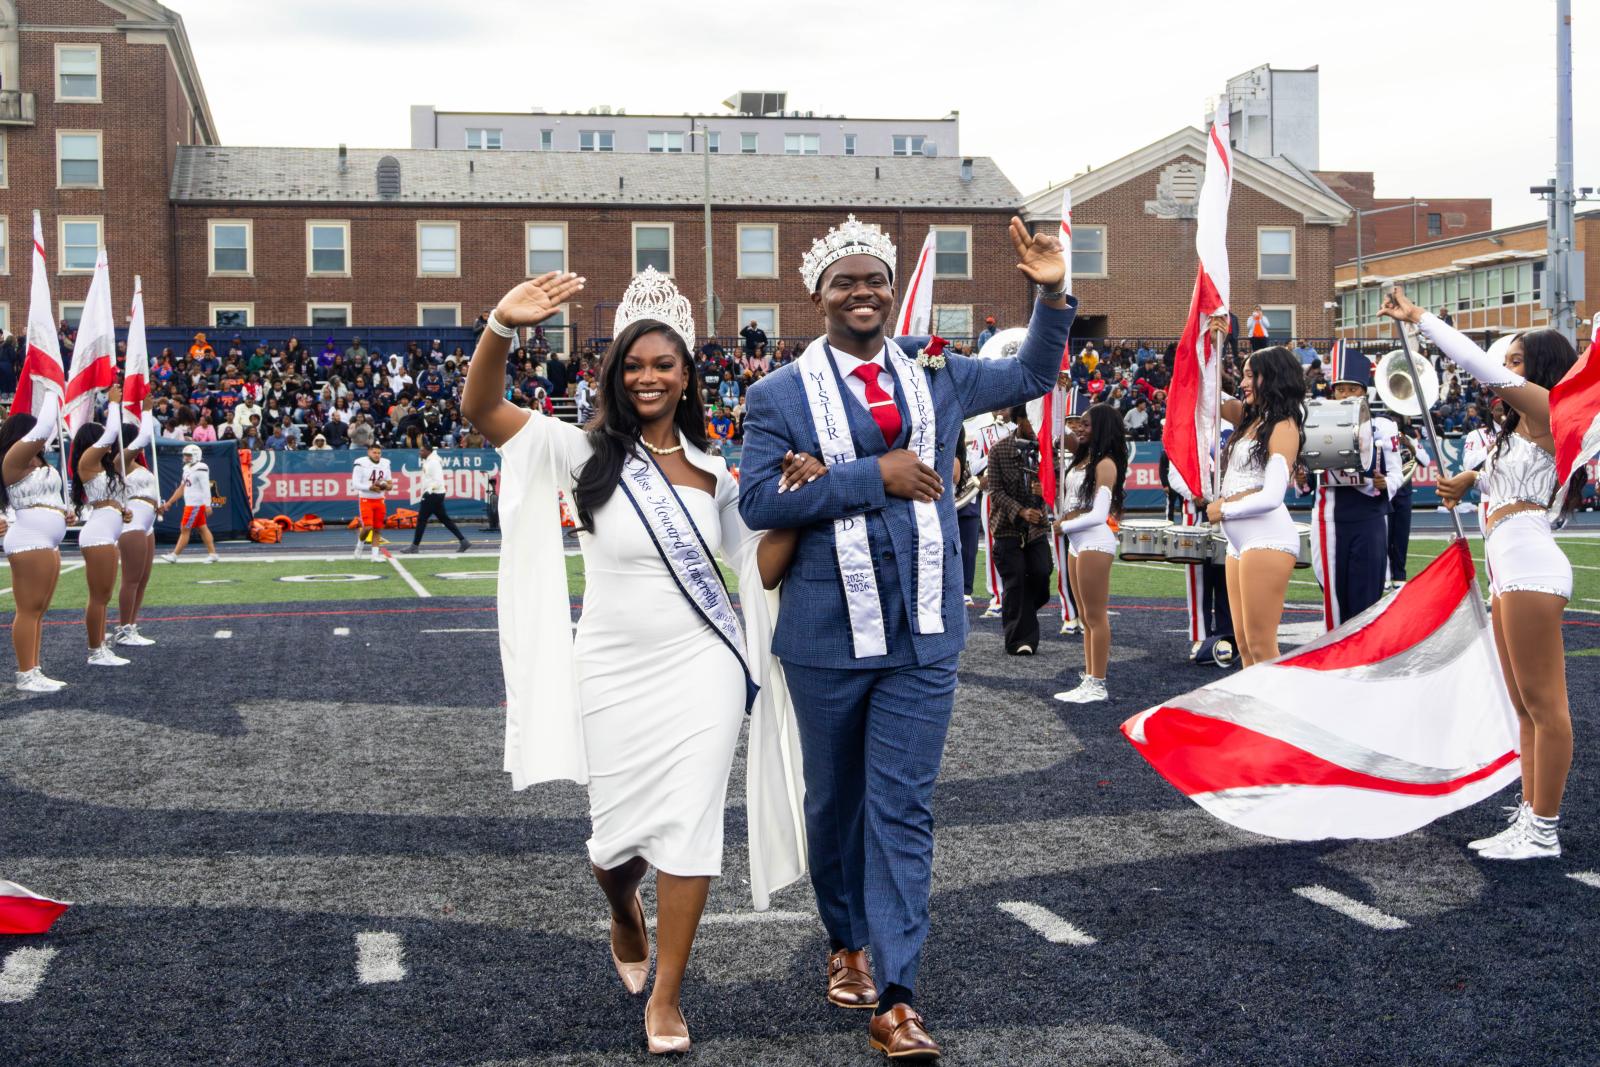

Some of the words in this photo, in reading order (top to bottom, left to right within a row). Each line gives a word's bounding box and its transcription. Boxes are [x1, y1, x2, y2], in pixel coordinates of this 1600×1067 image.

[809, 372, 839, 440] MISTER
[896, 350, 928, 463] NIVERSIT
[418, 456, 482, 467] HWARD
[275, 479, 339, 497] BLEED
[346, 478, 399, 496] BE
[404, 465, 496, 505] BSON
[624, 460, 653, 492] Miss
[646, 495, 693, 550] Howard
[682, 550, 719, 612] University
[845, 572, 869, 584] 2025-
[848, 582, 870, 593] 2026
